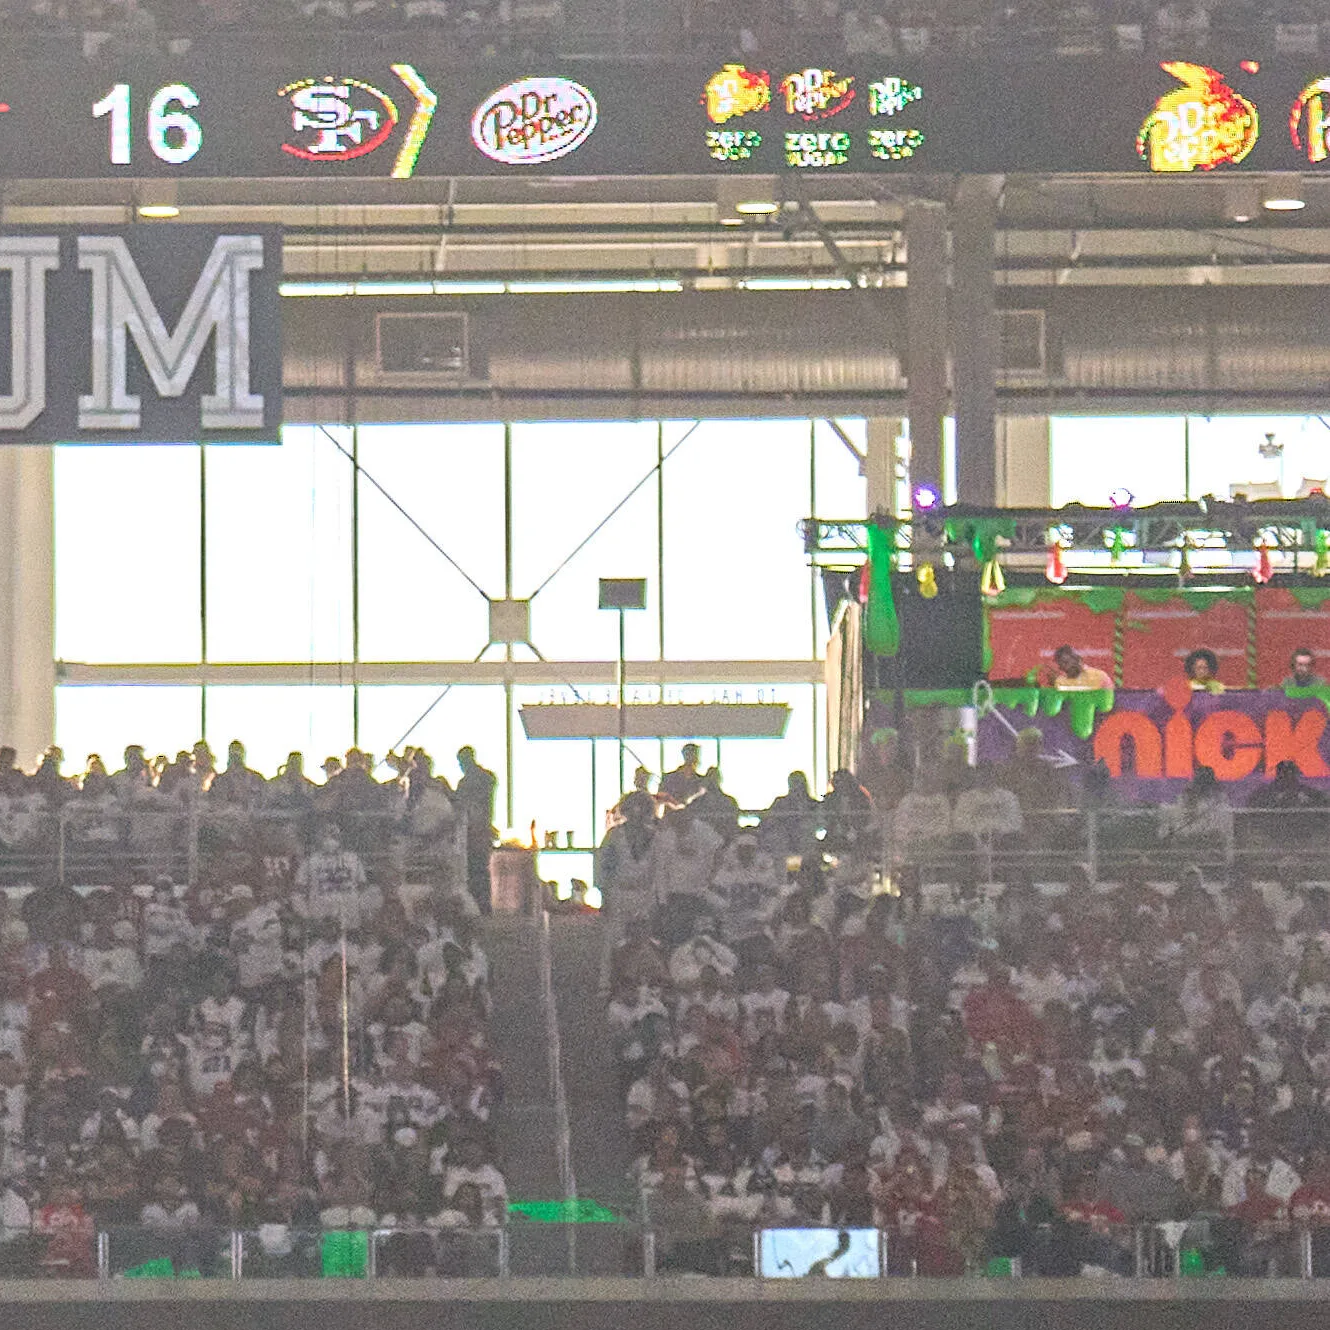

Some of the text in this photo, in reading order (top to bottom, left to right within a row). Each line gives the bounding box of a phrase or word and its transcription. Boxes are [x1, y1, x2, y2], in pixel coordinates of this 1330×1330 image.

[92, 83, 203, 165] 16
[495, 102, 584, 151] Pepper
[521, 91, 558, 118] Dr
